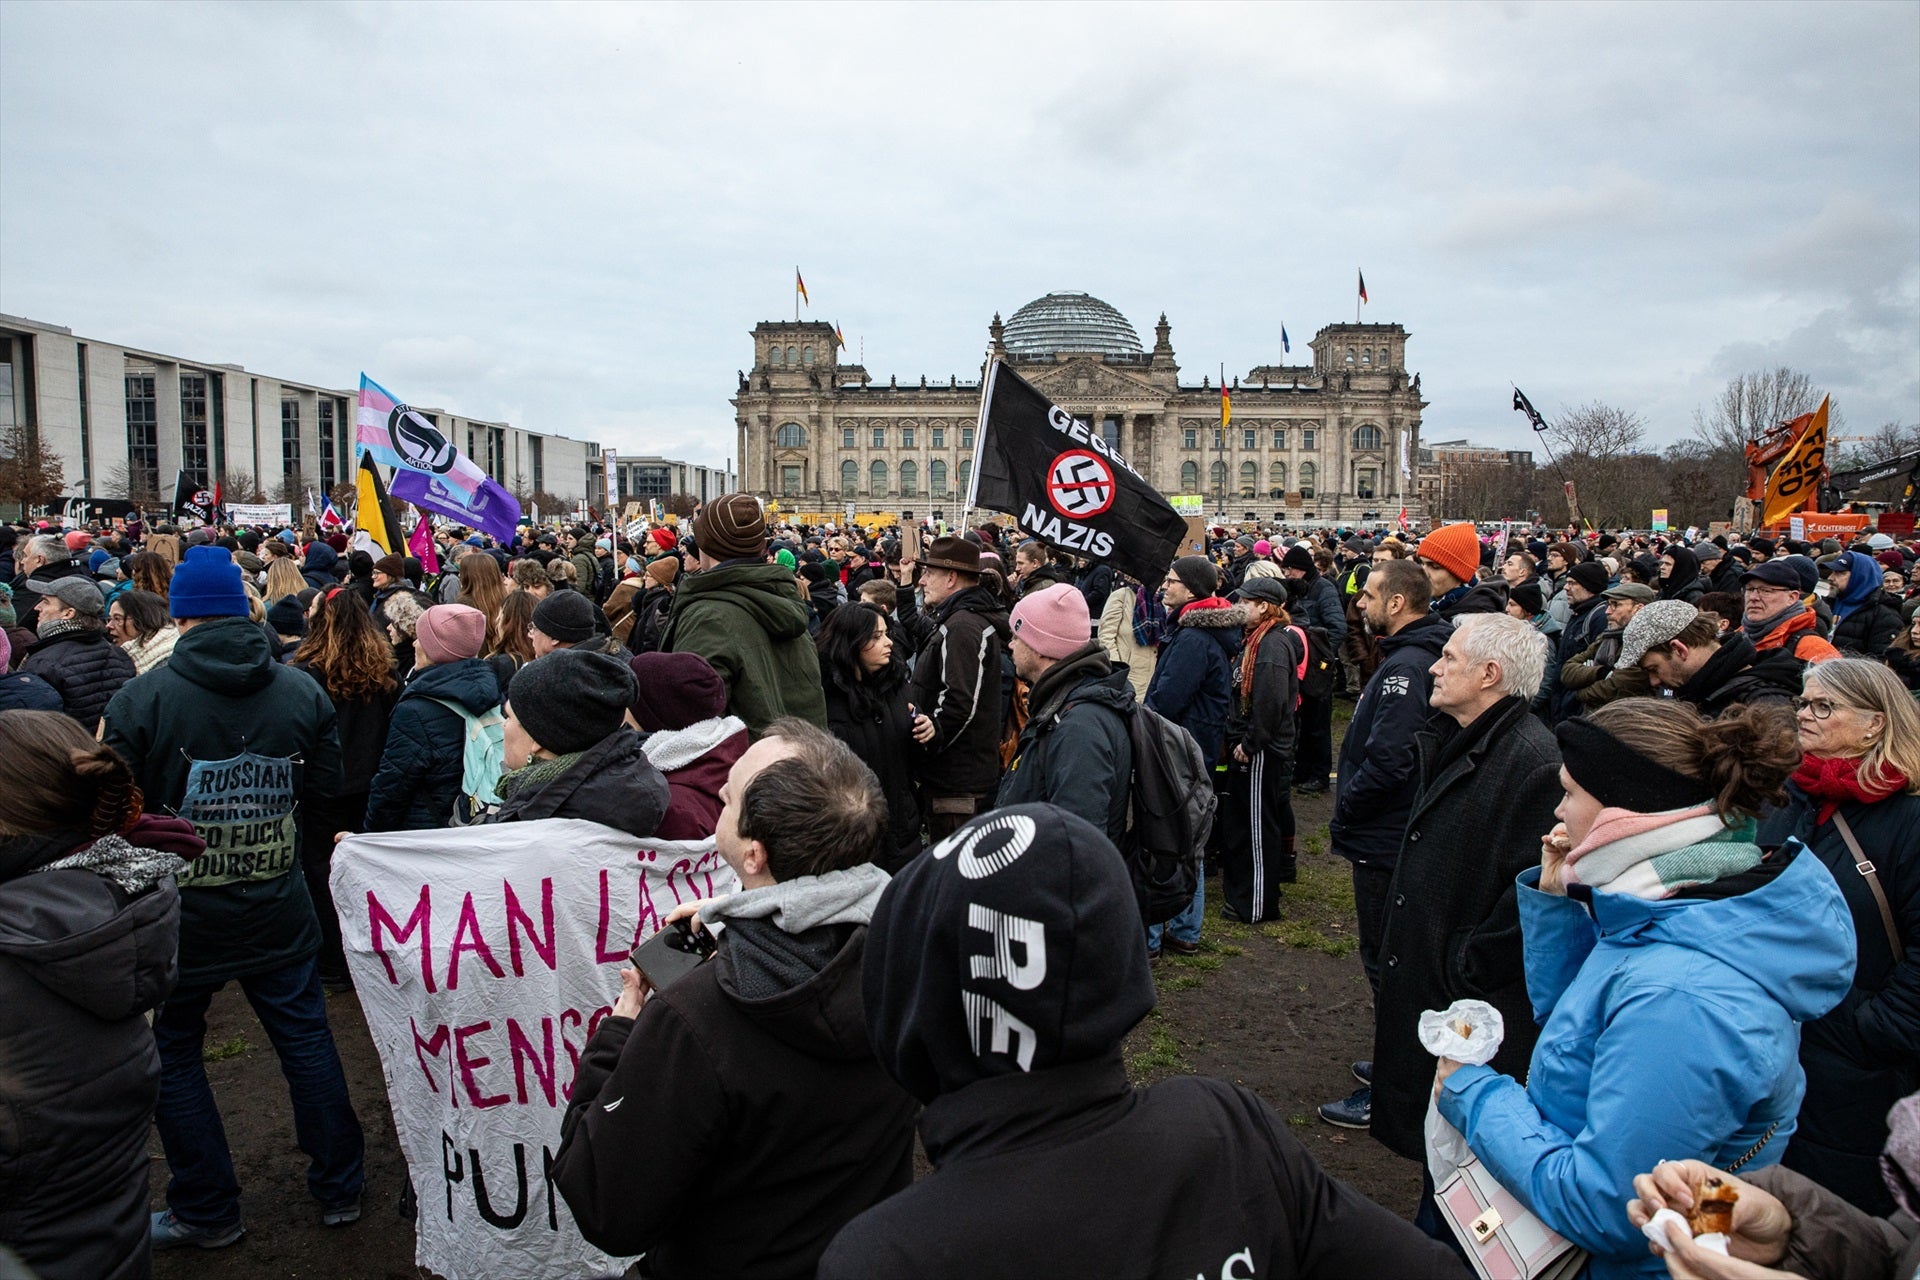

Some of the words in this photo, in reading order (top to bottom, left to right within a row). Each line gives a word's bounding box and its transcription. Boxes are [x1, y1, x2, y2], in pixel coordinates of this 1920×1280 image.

[182, 501, 208, 519] NAZIS
[1021, 502, 1114, 557] NAZIS
[1817, 525, 1857, 533] ECHTERHOFF
[201, 761, 289, 793] RUSSIAN
[230, 819, 285, 847] FUCK
[366, 877, 557, 994] MAN
[933, 814, 1047, 1073] ORE
